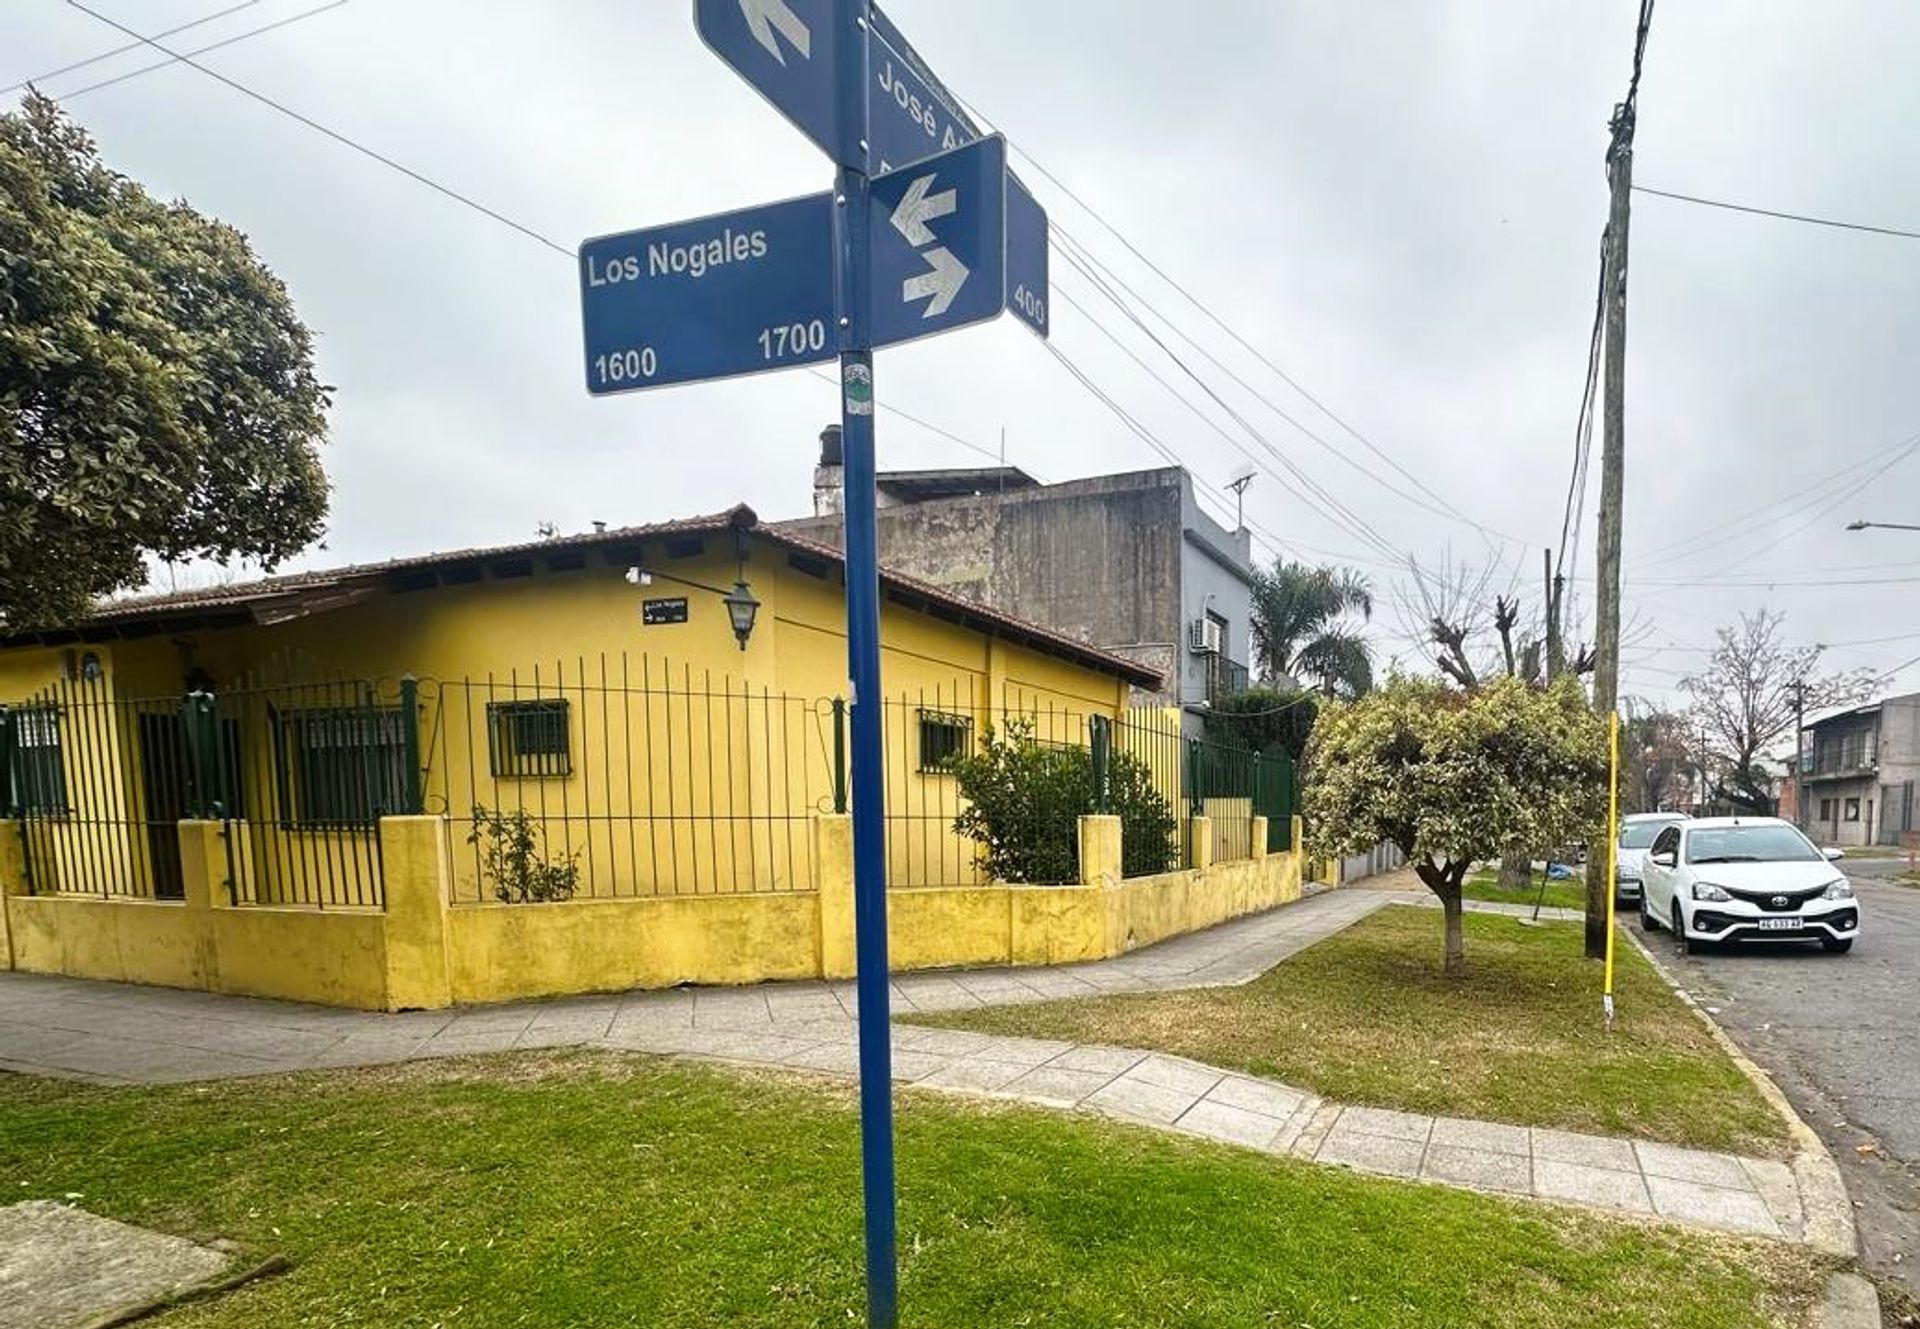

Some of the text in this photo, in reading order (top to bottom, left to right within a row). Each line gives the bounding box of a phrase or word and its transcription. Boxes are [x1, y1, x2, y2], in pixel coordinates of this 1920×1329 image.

[877, 61, 936, 137] José
[587, 229, 768, 287] Los Nogales
[1014, 283, 1044, 325] 400
[758, 319, 825, 360] 1700
[595, 346, 658, 383] 1600
